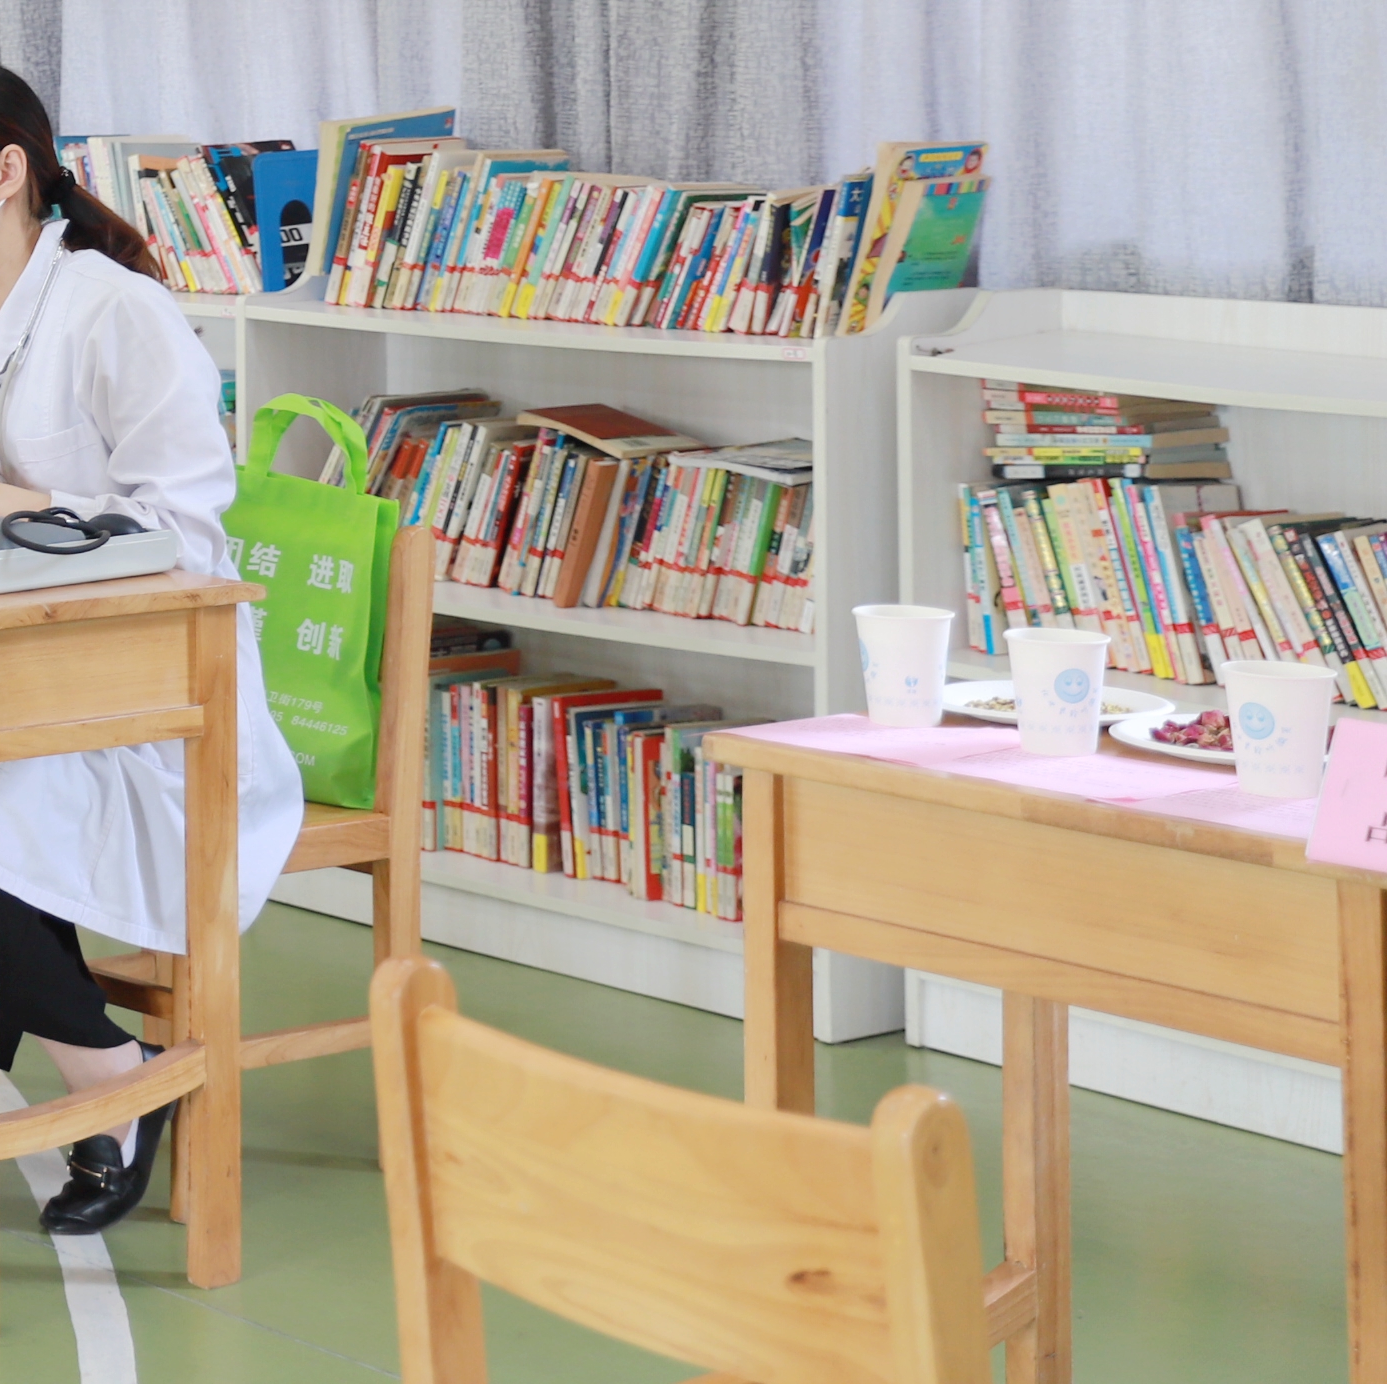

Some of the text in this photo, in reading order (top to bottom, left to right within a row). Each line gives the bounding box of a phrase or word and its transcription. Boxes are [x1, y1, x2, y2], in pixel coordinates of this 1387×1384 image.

[308, 555, 353, 593] 进取
[297, 619, 343, 660] 创新
[291, 751, 315, 765] OM
